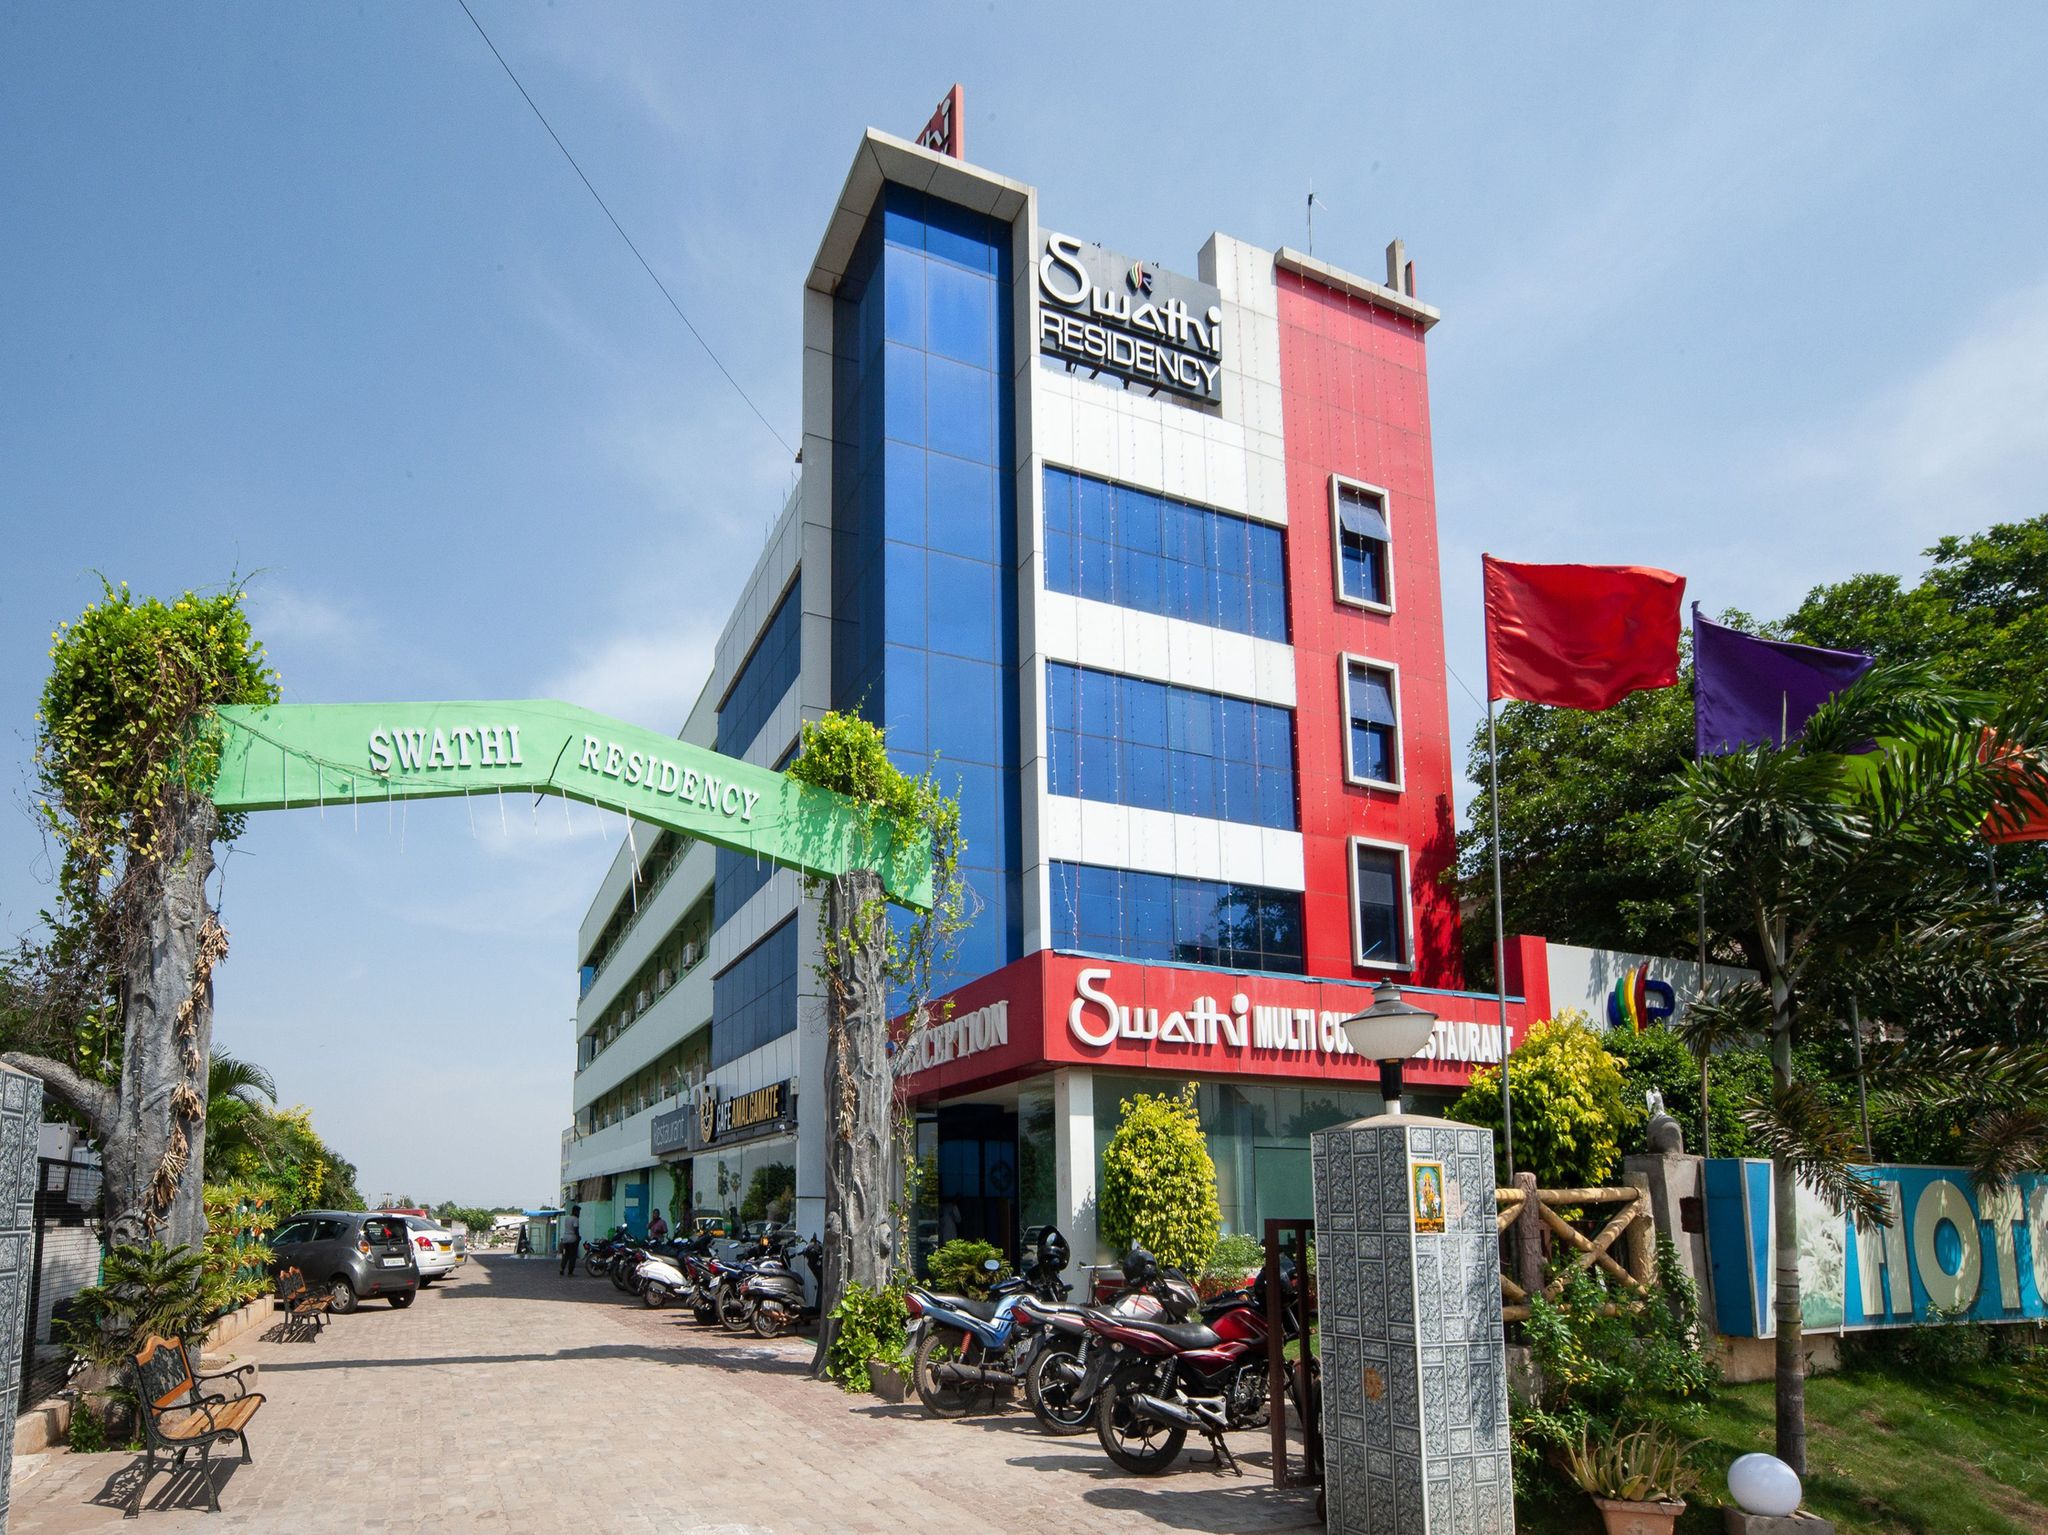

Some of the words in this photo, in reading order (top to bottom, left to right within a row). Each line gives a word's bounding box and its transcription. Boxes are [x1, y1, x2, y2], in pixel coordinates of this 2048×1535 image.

[1039, 232, 1222, 352] Swathi
[1040, 309, 1221, 392] RESIDENCY
[369, 726, 524, 773] SWATHI
[579, 734, 762, 823] RESIDENCY
[1068, 968, 1249, 1047] Swathi
[1252, 1005, 1316, 1051] MULTI
[731, 1084, 780, 1129] AMALGAMATE
